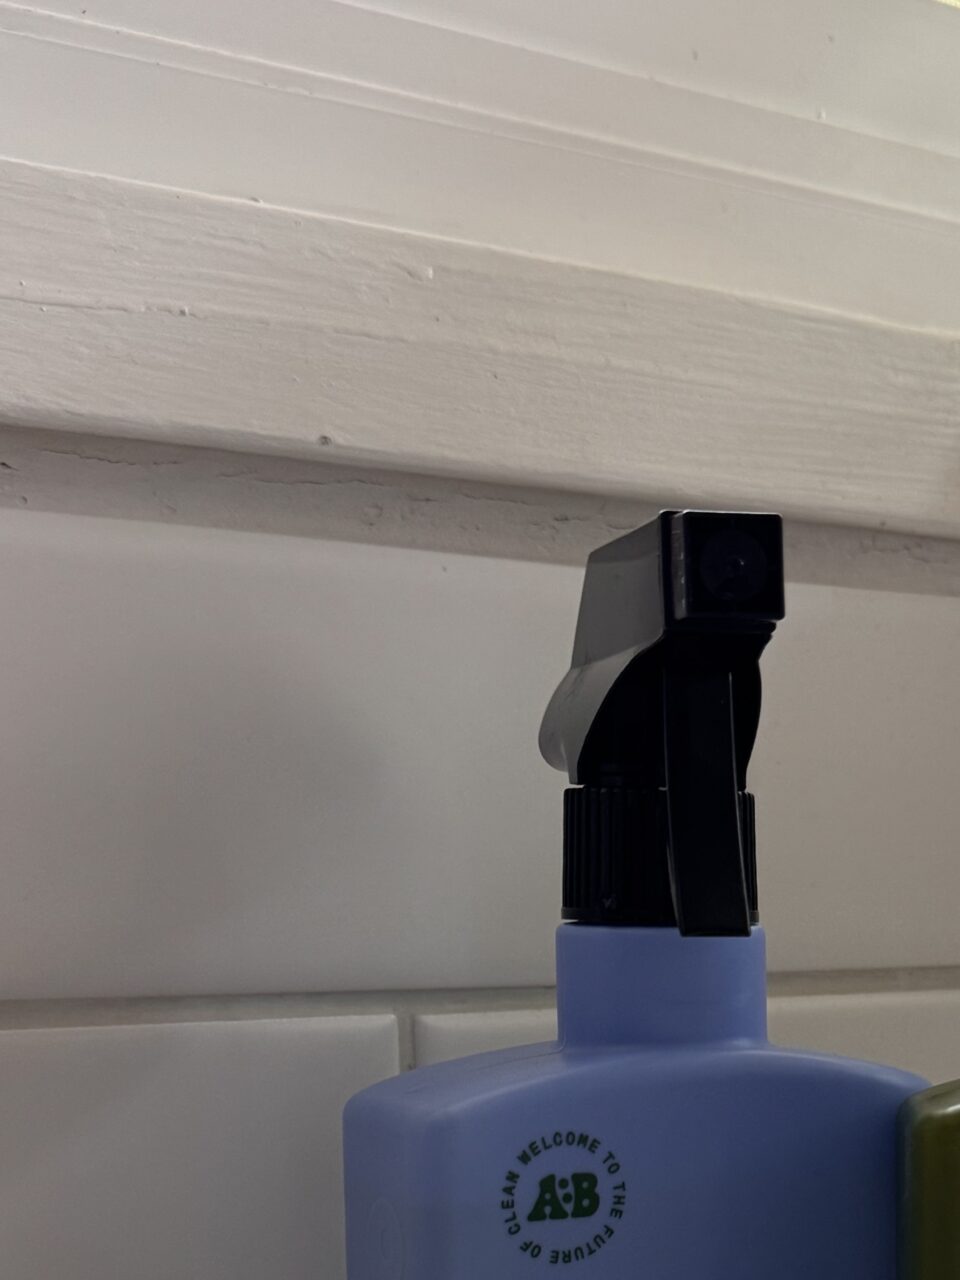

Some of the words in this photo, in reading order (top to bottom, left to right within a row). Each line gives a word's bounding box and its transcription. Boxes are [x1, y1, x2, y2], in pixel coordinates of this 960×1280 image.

[517, 1131, 601, 1165] WELCOME
[603, 1152, 621, 1174] TO
[501, 1170, 520, 1235] CLEAN
[610, 1182, 626, 1219] THE
[519, 1241, 542, 1258] OF
[550, 1225, 614, 1264] FUTURE
